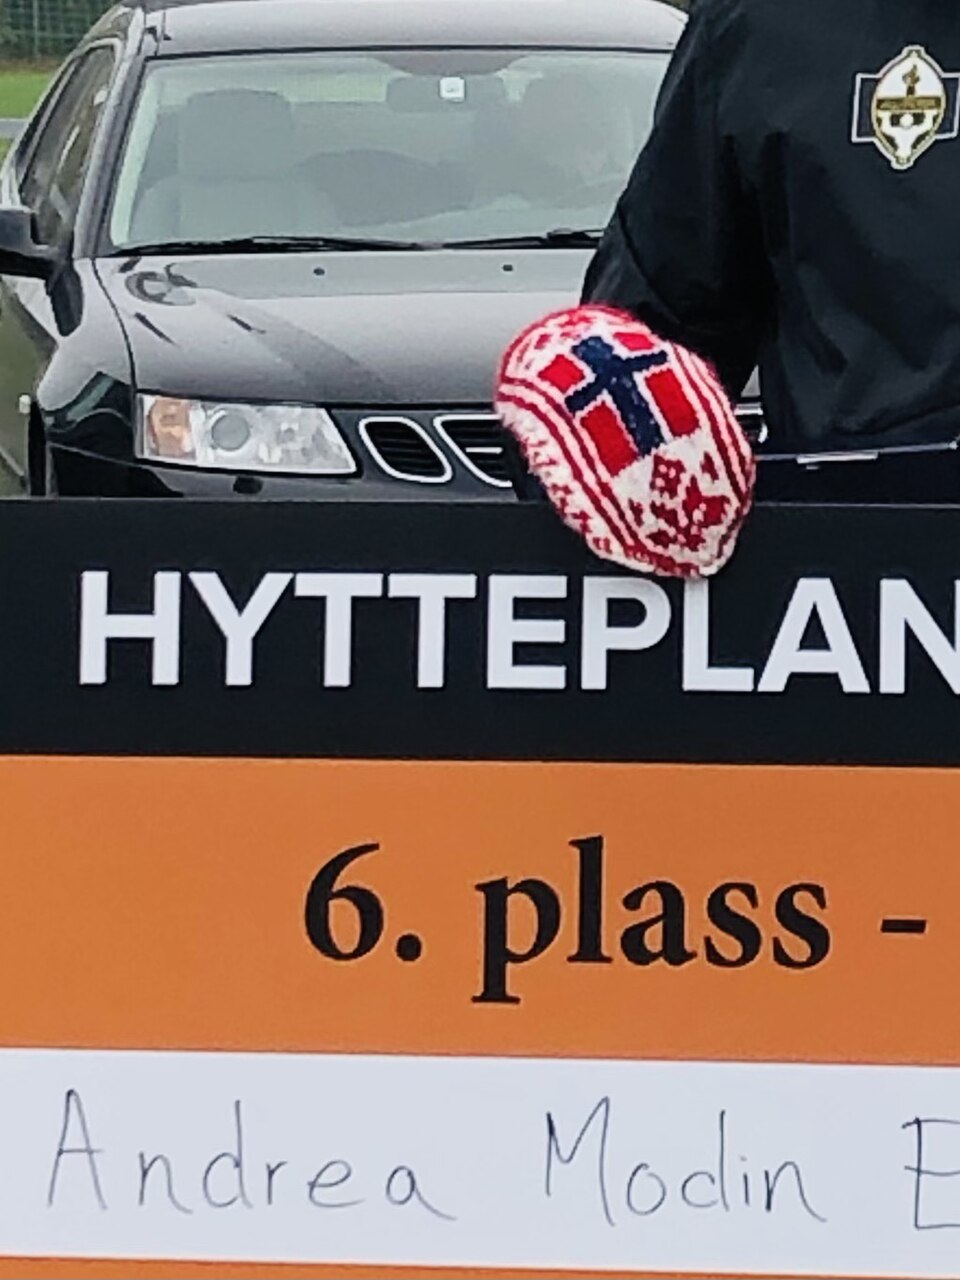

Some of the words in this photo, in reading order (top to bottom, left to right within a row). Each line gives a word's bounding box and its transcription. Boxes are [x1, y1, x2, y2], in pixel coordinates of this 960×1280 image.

[304, 842, 422, 962] 6.
[470, 834, 831, 1005] plass
[47, 1088, 455, 1221] Andrea
[545, 1095, 828, 1227] Modin
